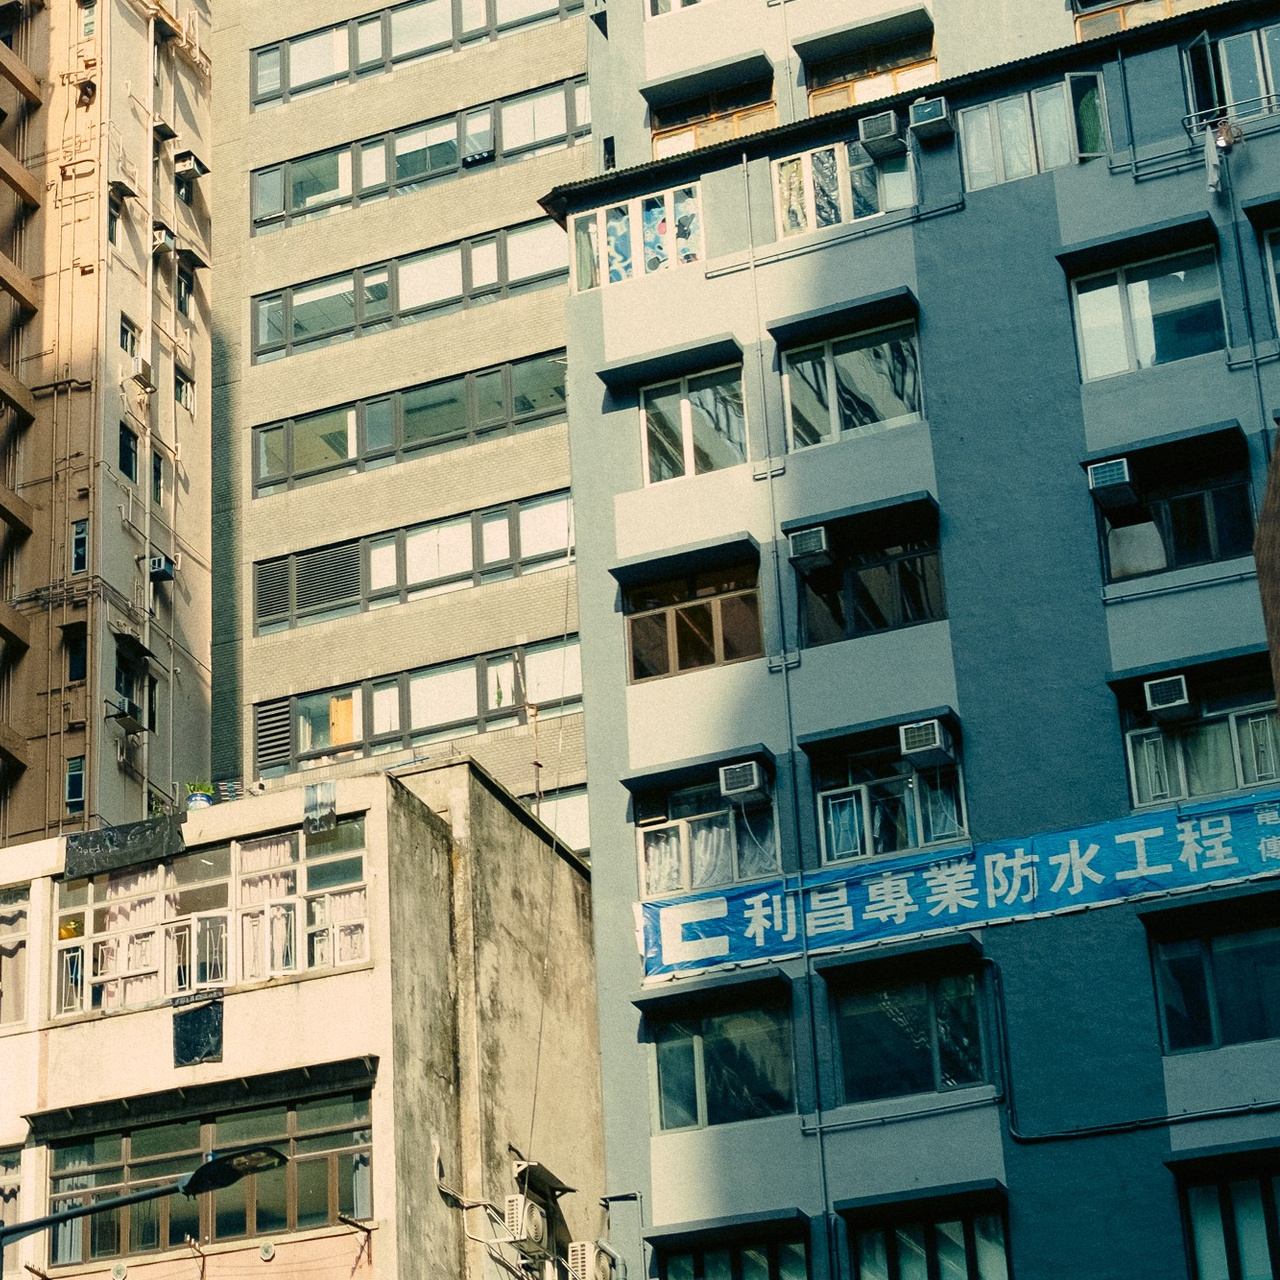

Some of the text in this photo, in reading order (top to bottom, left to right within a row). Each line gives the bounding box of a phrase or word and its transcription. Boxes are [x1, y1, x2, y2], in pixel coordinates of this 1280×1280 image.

[743, 815, 1240, 948] 利昌專業防水工程
